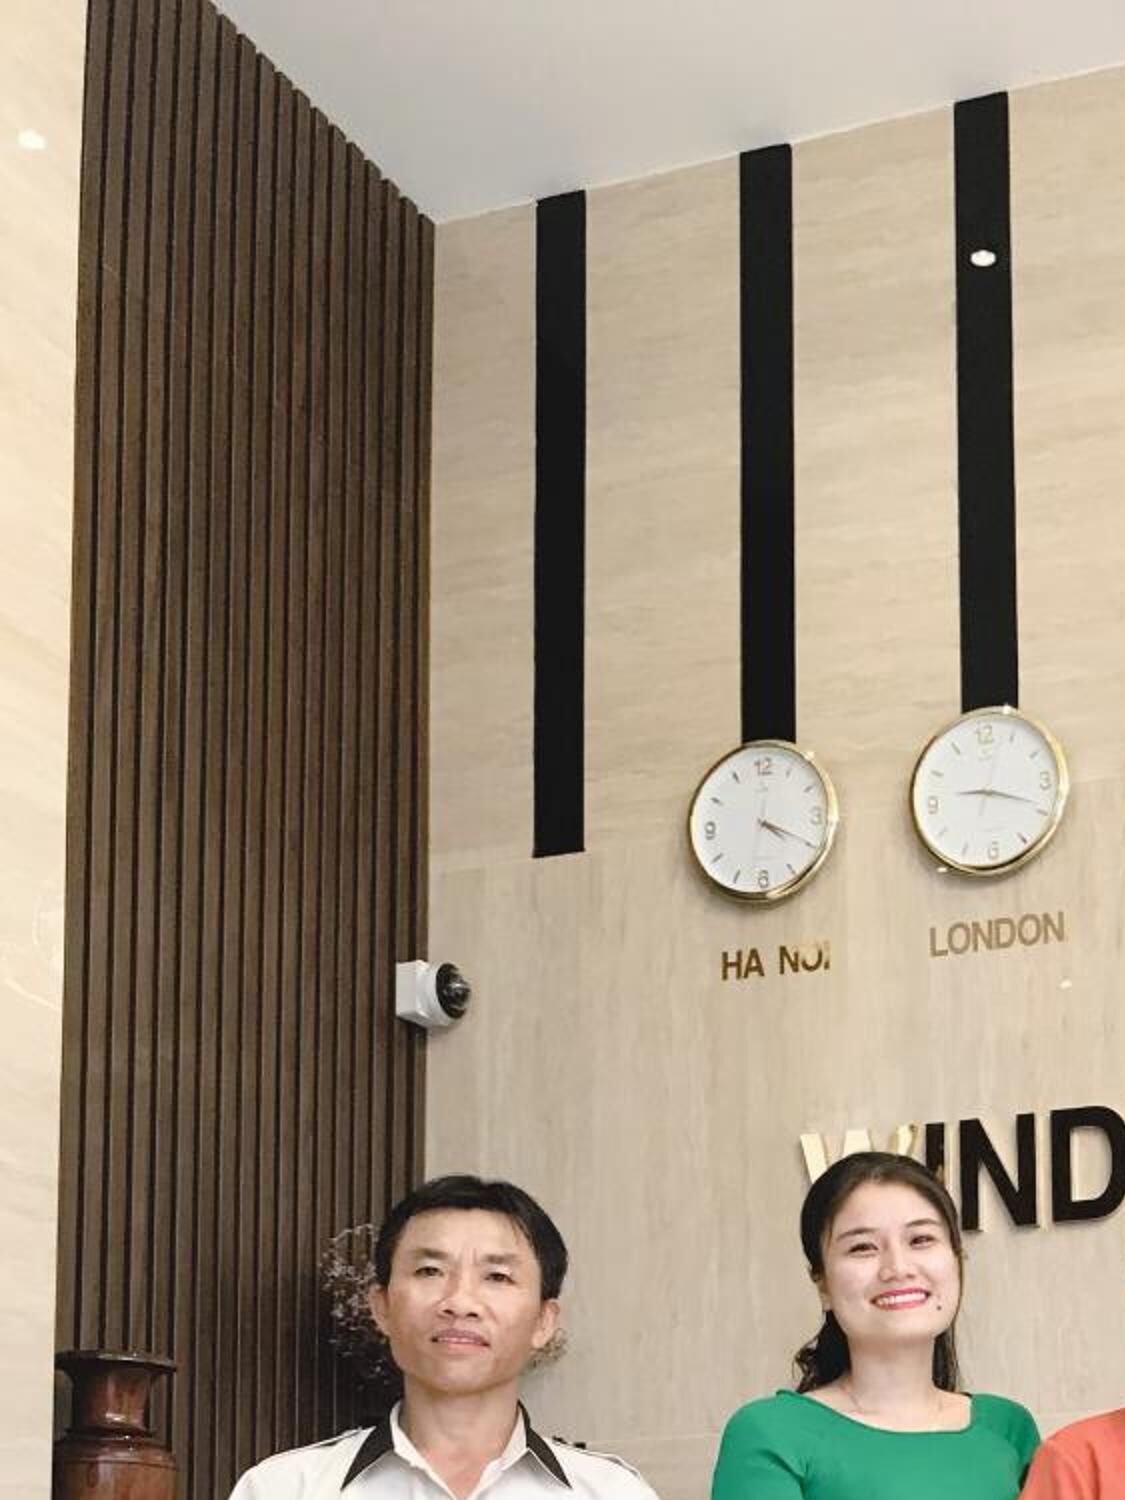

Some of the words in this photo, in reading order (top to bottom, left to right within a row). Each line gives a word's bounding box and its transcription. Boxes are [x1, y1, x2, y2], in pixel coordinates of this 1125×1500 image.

[975, 724, 994, 743] 12
[754, 757, 774, 776] 12
[1039, 771, 1050, 790] 3
[928, 796, 938, 814] 9
[811, 805, 822, 825] 3
[705, 821, 716, 840] 9
[987, 841, 998, 859] 6
[758, 869, 769, 888] 6
[930, 910, 1064, 957] LONDON
[722, 948, 765, 980] HA
